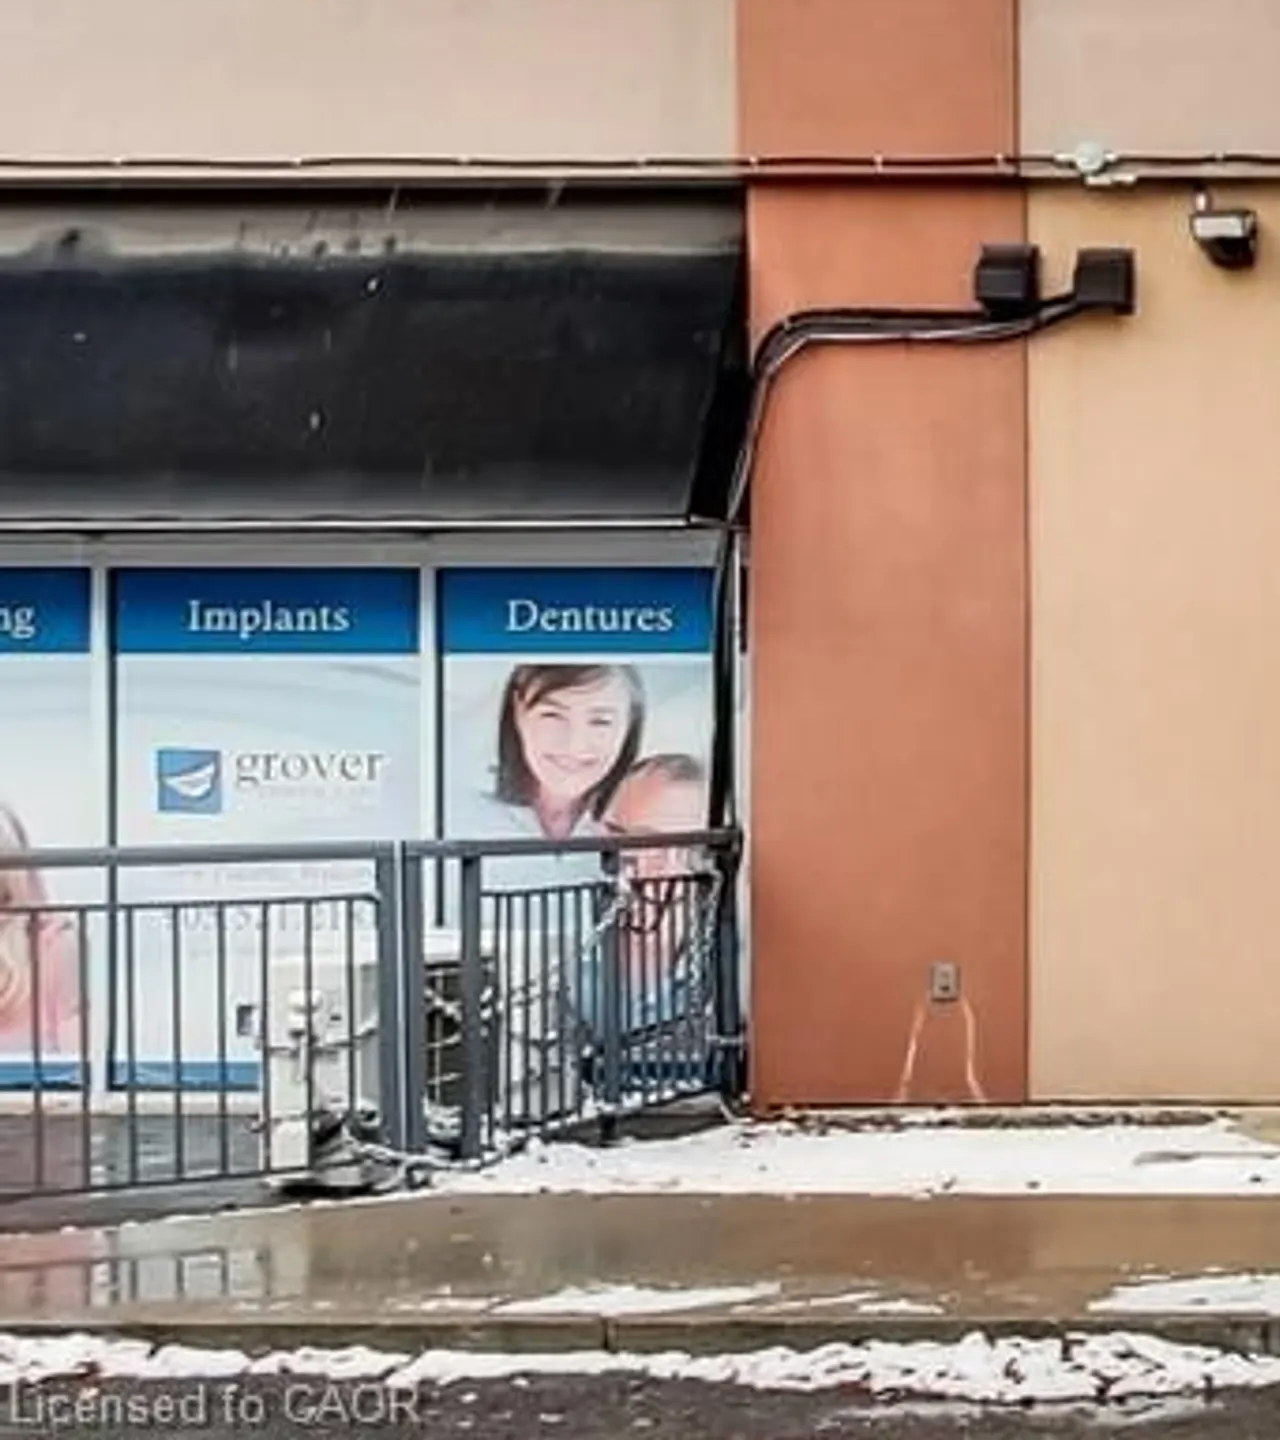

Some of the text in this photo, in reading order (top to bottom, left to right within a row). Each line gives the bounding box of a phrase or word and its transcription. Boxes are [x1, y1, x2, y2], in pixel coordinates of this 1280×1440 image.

[188, 599, 350, 637] Implants
[507, 599, 673, 632] Dentures
[235, 750, 384, 791] grover
